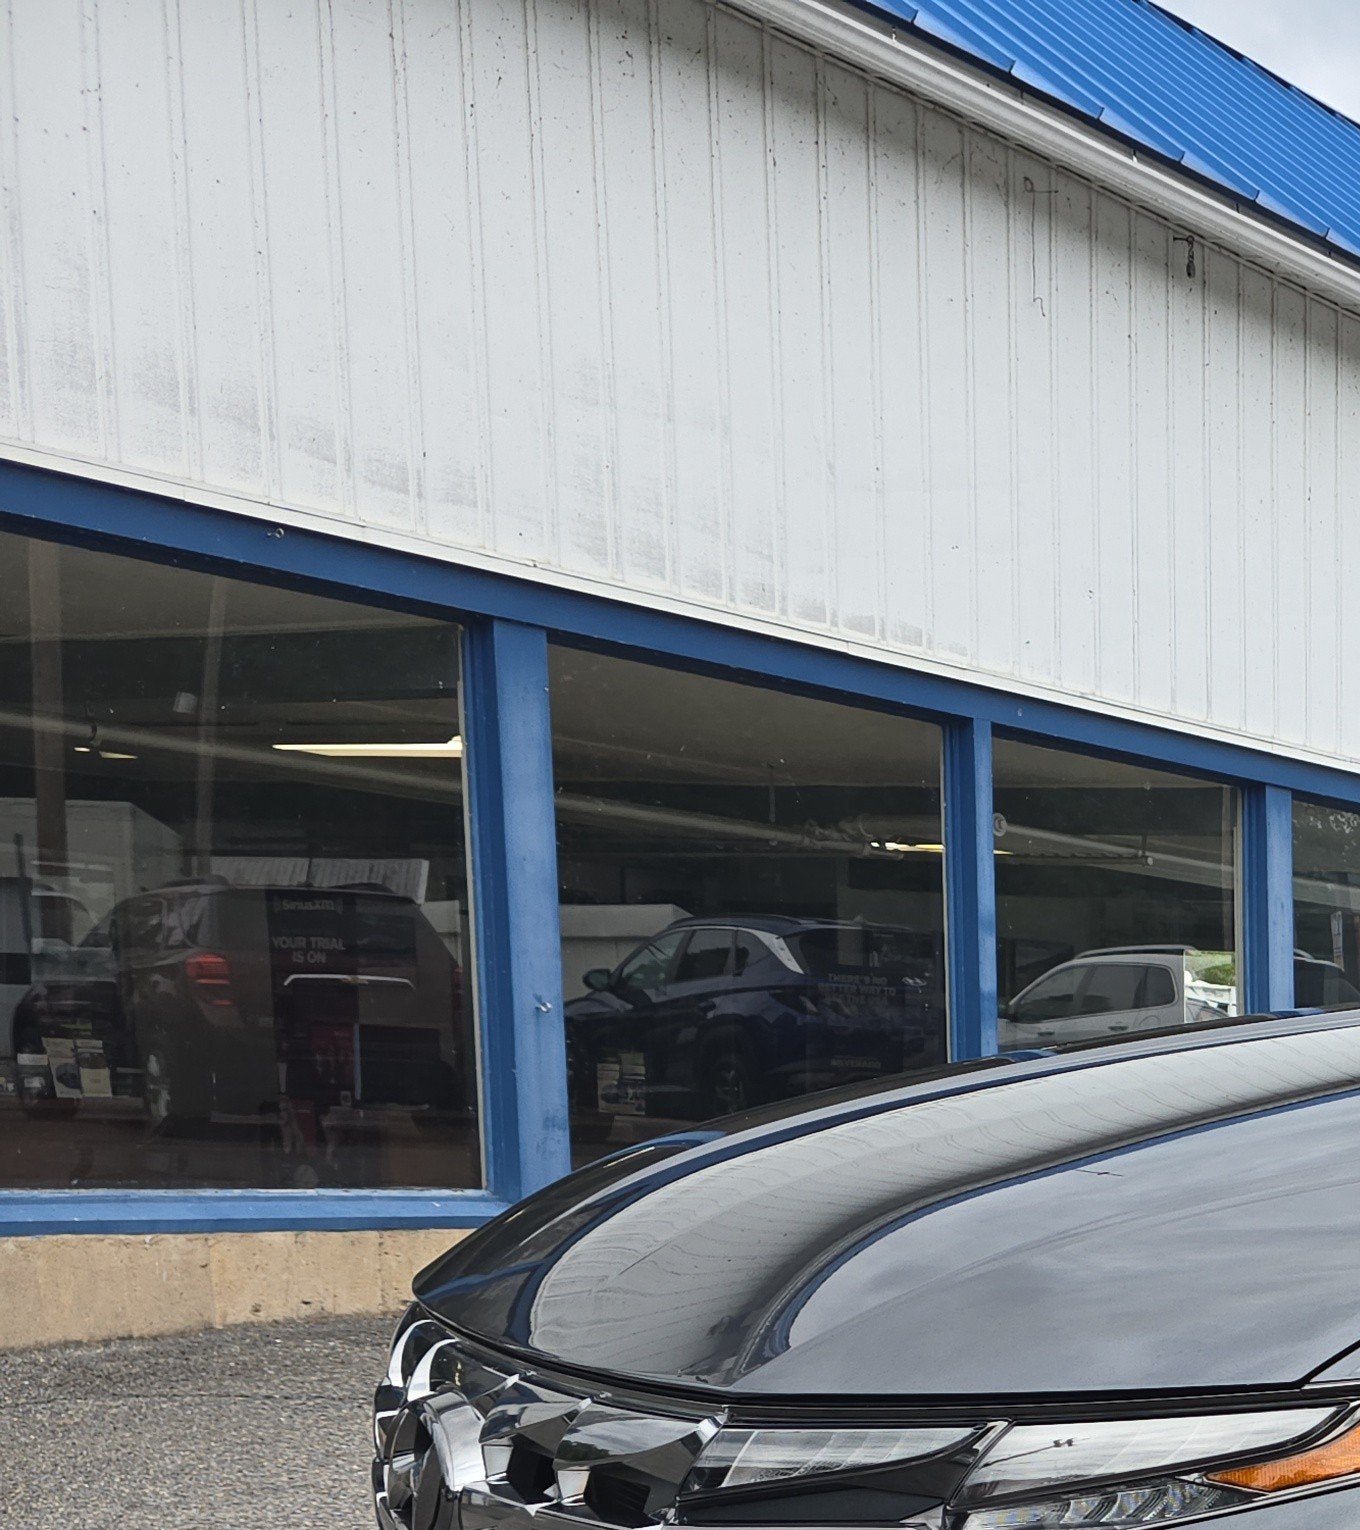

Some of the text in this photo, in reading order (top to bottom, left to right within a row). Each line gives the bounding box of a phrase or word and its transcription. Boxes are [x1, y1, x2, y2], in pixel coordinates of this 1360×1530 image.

[271, 937, 346, 951] YOUR TRIAL
[291, 951, 327, 964] IS ON
